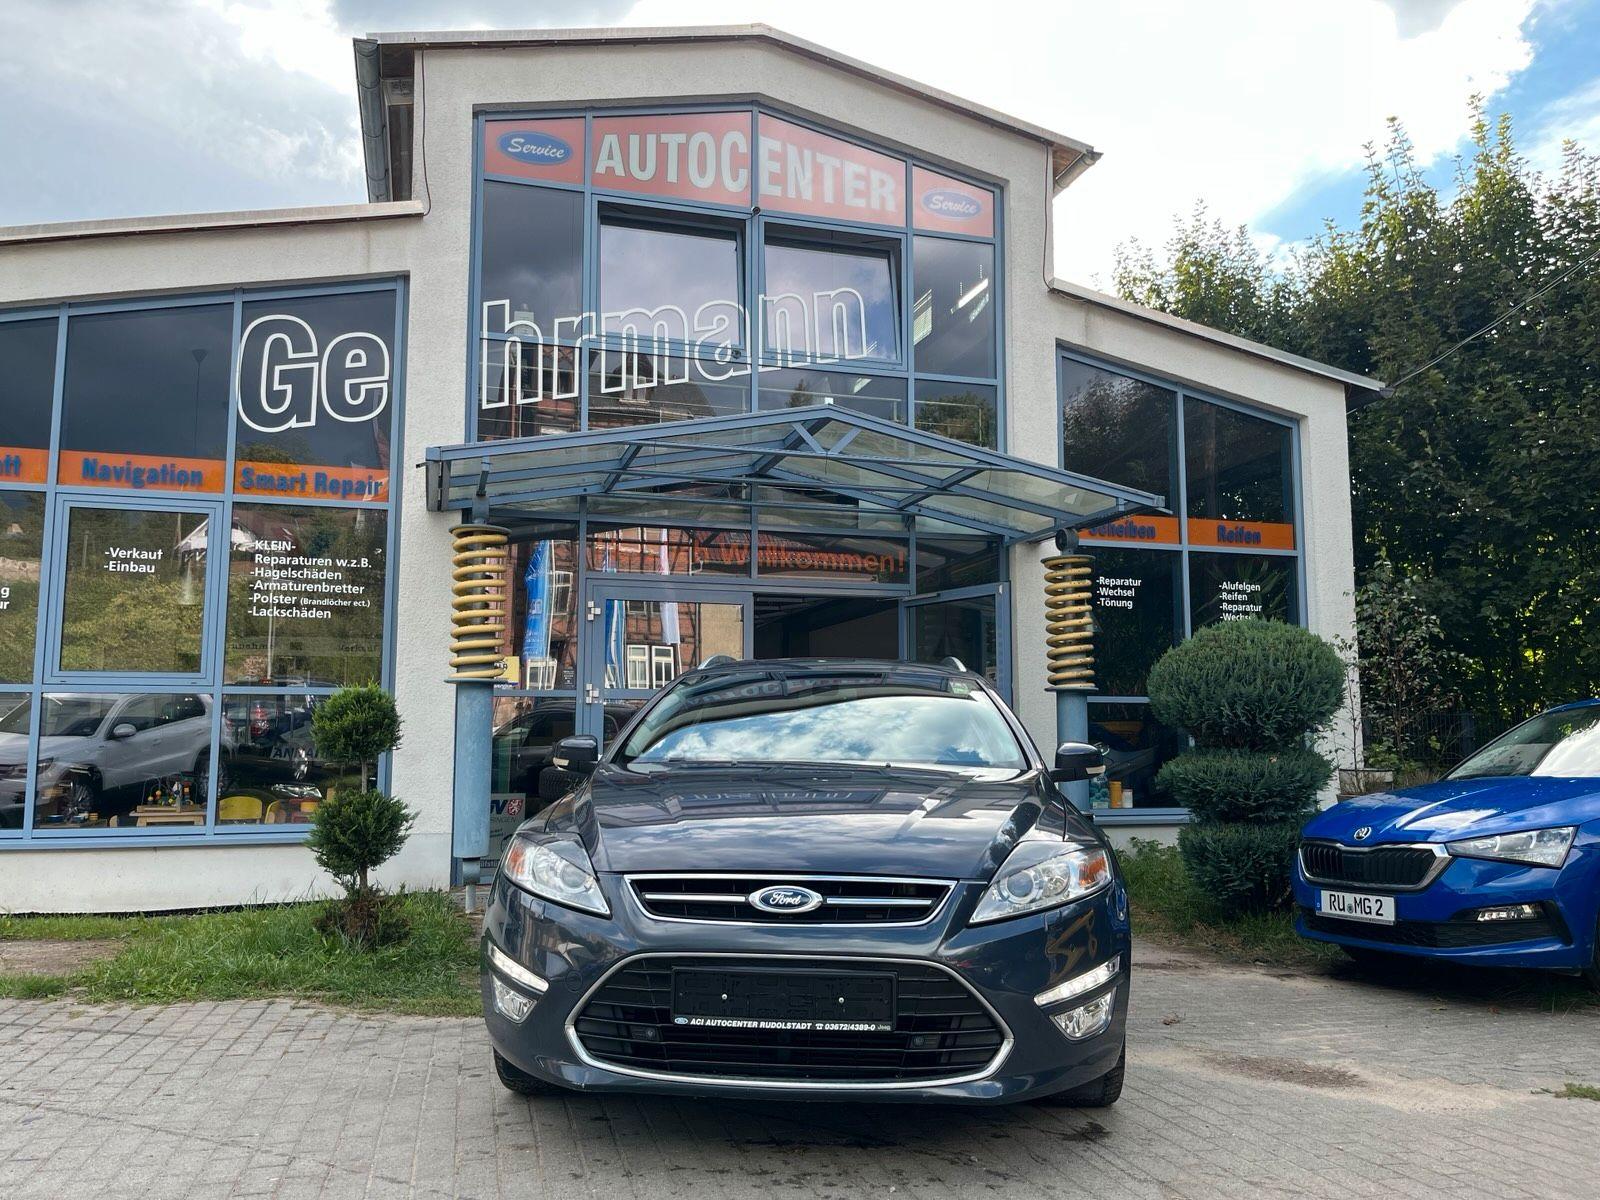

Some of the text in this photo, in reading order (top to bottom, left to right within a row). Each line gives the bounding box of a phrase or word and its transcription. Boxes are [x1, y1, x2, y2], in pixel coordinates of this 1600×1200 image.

[507, 138, 565, 159] Service
[595, 131, 897, 213] AUTOCENTER
[929, 195, 977, 215] Service
[481, 287, 867, 410] hrmann
[236, 314, 390, 433] Ge
[82, 457, 203, 488] Navigation
[240, 466, 383, 497] Smart Repair
[1217, 525, 1262, 544] Reifen
[105, 547, 163, 560] -Verkauf
[103, 561, 155, 573] -Einbau
[255, 554, 372, 568] Reparaturen w.z.B.
[250, 567, 342, 580] -Hagelschäden
[249, 580, 365, 594] -Armaturenbretter
[1096, 577, 1141, 589] -Reparatur
[1219, 582, 1261, 593] -Alufelgen
[249, 593, 297, 604] -Polster
[300, 598, 351, 607] (Brandlöcher
[1097, 588, 1135, 598] -Wechsel
[1219, 592, 1248, 601] -Reifen
[1097, 598, 1133, 610] -Tönung
[1219, 602, 1262, 613] -Reparatur
[248, 606, 331, 619] -Lackschäden
[769, 890, 801, 905] Ford
[1329, 893, 1384, 917] RU MG 2
[690, 1018, 704, 1026] ACI
[705, 1019, 758, 1028] AUTOCENTER
[759, 1021, 812, 1030] RUDOLSTADT
